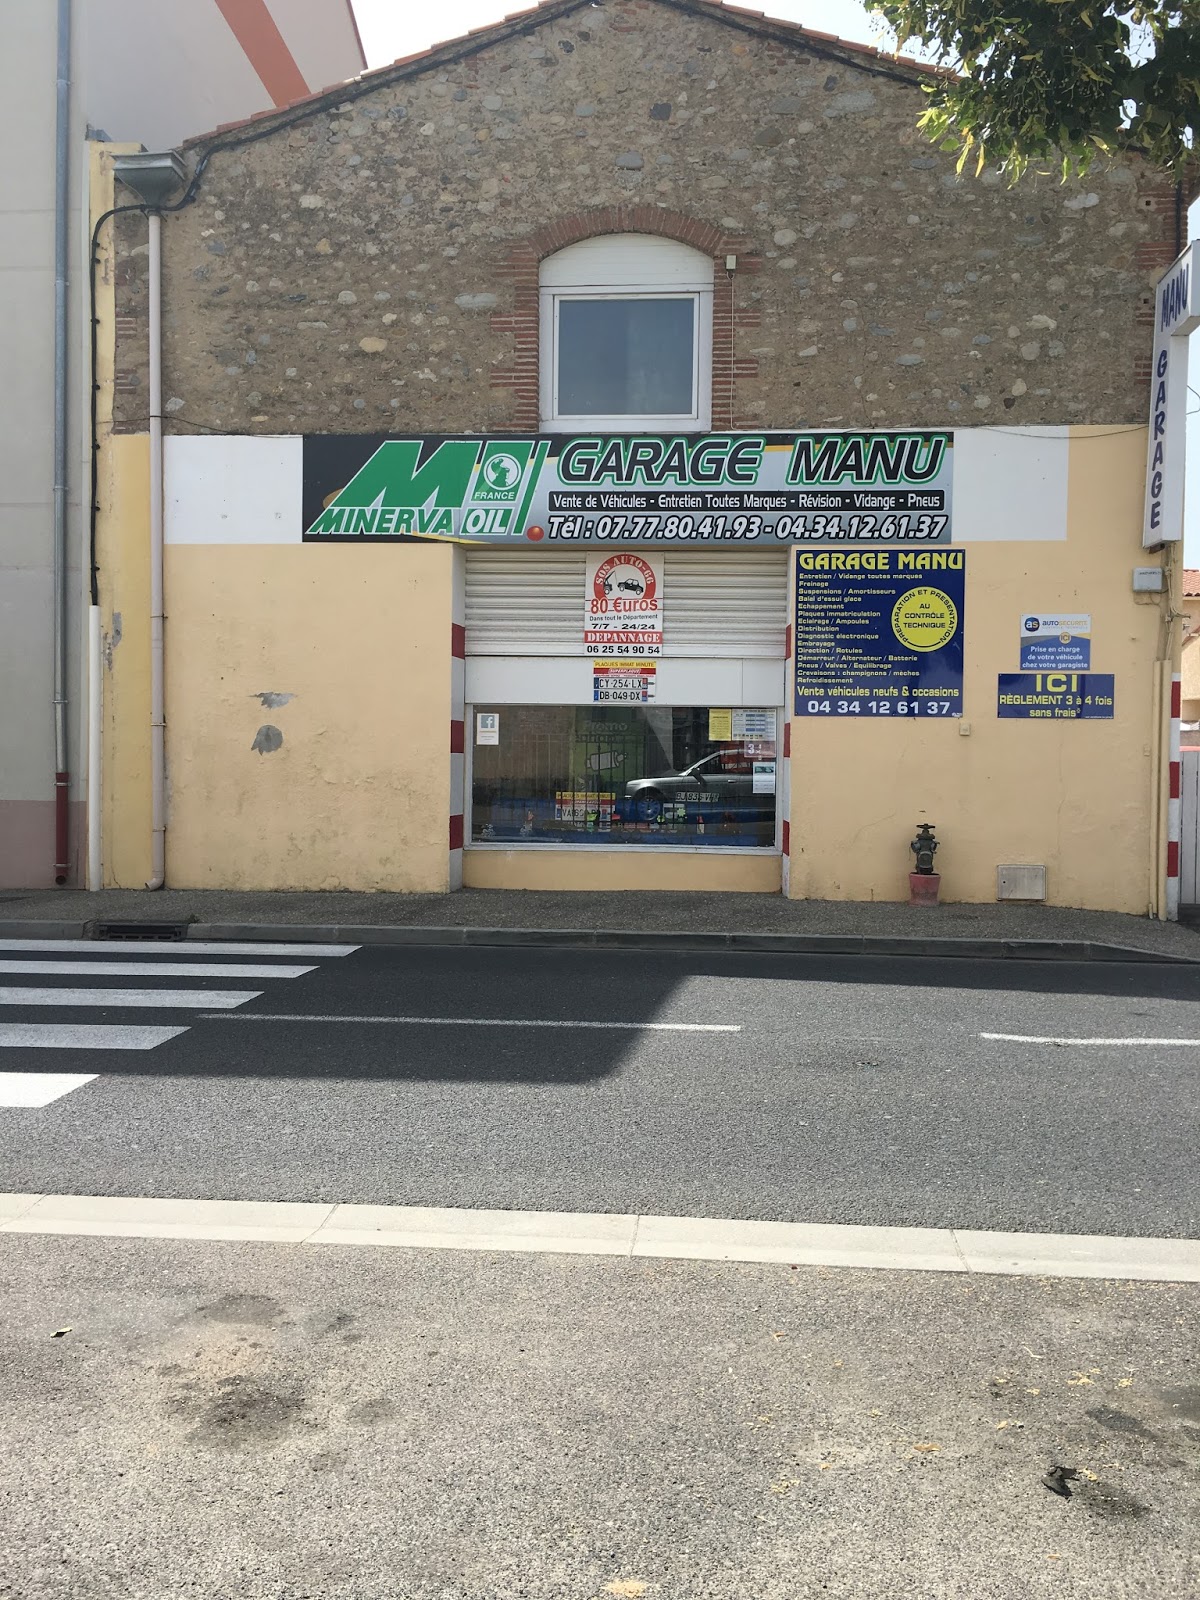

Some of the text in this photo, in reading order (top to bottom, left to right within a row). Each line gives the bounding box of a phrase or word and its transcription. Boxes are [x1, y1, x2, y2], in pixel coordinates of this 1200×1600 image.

[1160, 263, 1189, 332] MANU
[1150, 349, 1168, 530] GARAGE
[558, 437, 945, 484] GARAGE MANU
[474, 491, 515, 500] FRANCE
[553, 494, 582, 508] Vente
[585, 494, 597, 508] de
[600, 494, 646, 508] Véhicules
[658, 494, 701, 508] Entretien
[705, 494, 739, 507] Toutes
[743, 494, 787, 510] Marques
[799, 494, 841, 507] Révision
[854, 494, 896, 510] Vidange
[908, 494, 940, 507] Pneus
[305, 508, 514, 534] MINERVA OIL
[597, 516, 761, 538] 07.77.80.41.93
[776, 516, 948, 538] 04.34.12.61.37
[800, 552, 963, 570] GARAGE MANU
[596, 555, 654, 584] SOS AUTO-66
[591, 598, 608, 614] 80
[623, 613, 658, 621] Département
[894, 591, 916, 643] PREPARATION
[930, 590, 955, 643] PRESENTATION
[904, 611, 945, 619] CONTRÔLE
[1026, 620, 1038, 629] as
[587, 632, 660, 642] DEPANNAGE
[587, 645, 660, 654] 06 25 54 90 54
[599, 679, 642, 689] CY-254-LX
[1036, 674, 1078, 692] ICI
[599, 691, 641, 700] DB-049-DX
[797, 686, 959, 697] Vente véhicules neufs & occasions
[1066, 695, 1073, 705] 3
[1076, 695, 1082, 705] à
[1085, 695, 1092, 705] 4
[1095, 695, 1113, 706] fois
[807, 701, 950, 714] 04 34 12 61 37
[1029, 709, 1052, 717] sans
